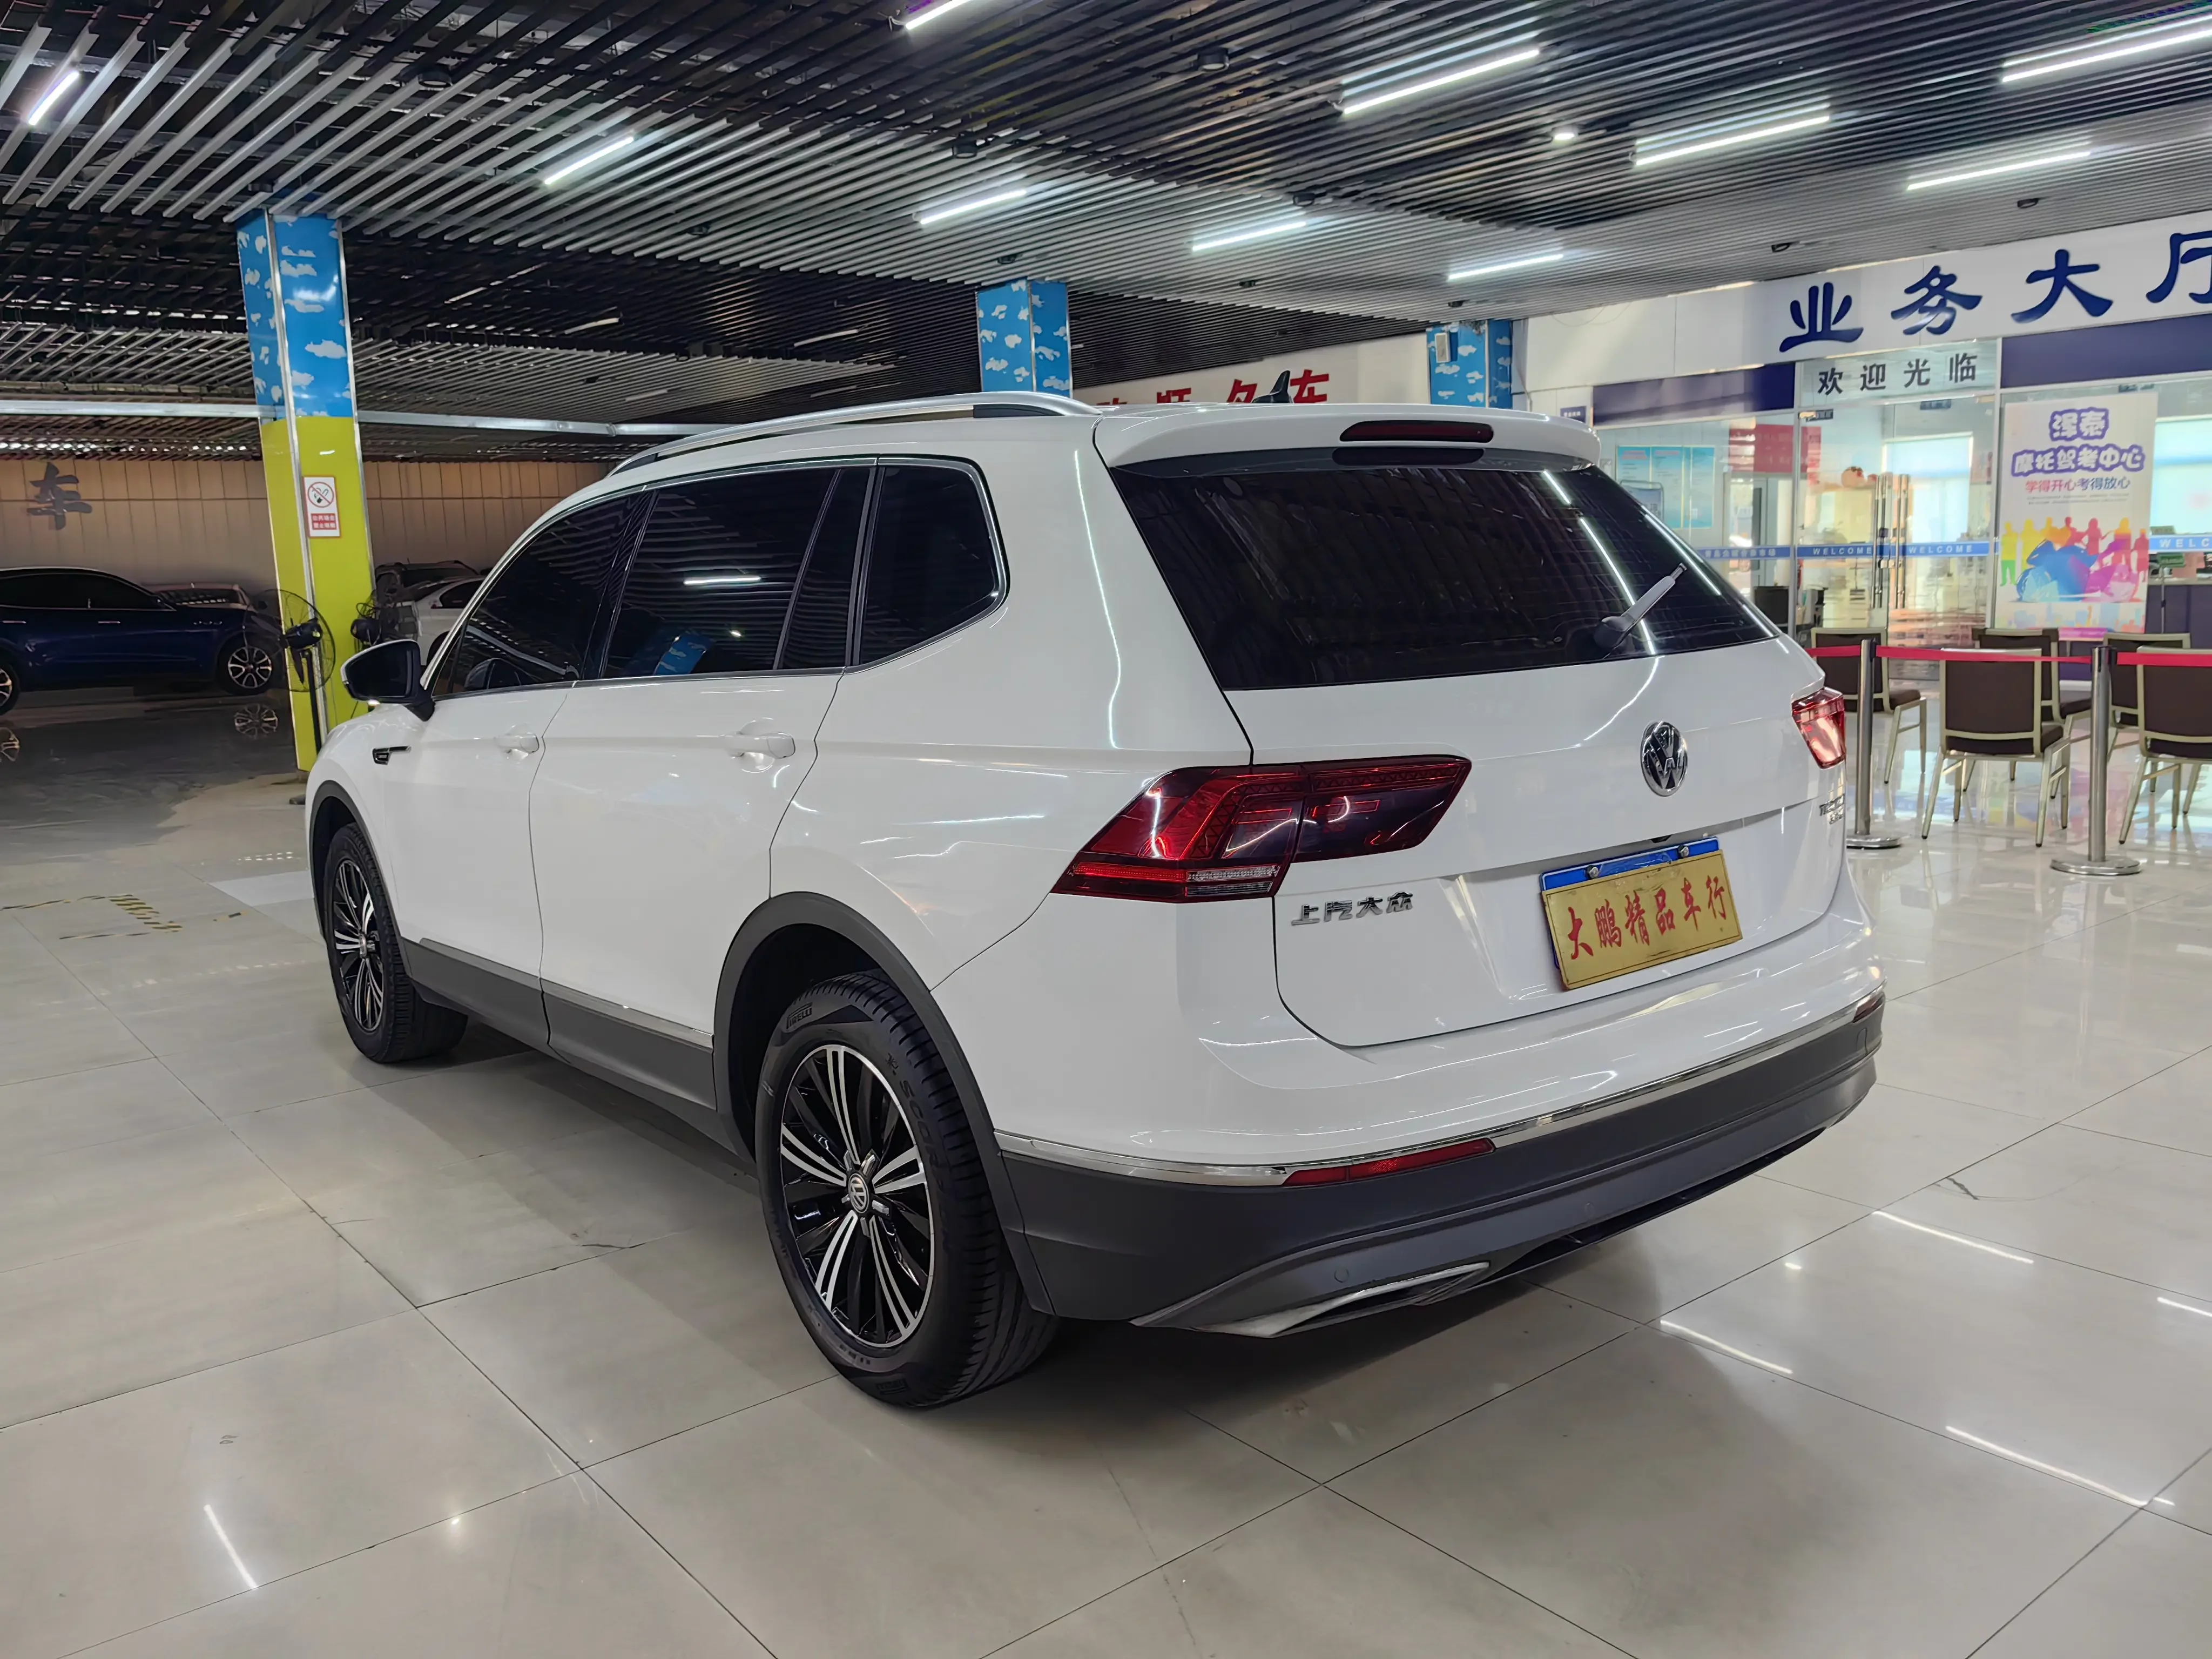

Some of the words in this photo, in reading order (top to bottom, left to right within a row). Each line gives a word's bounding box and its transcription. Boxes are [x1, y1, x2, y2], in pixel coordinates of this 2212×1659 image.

[1779, 230, 2212, 352] 业务大厅
[1818, 353, 1978, 395] 欢迎光临
[2012, 444, 2144, 476] 摩托驾考中心
[27, 462, 93, 530] 车
[1813, 547, 1872, 555] WELCOME
[1908, 544, 1973, 554] WELCOME
[2159, 537, 2210, 548] WELC
[1291, 892, 1413, 926] 上汽大众
[1568, 875, 1727, 960] 大鹏精品车行
[786, 1002, 813, 1029] PIRELLI
